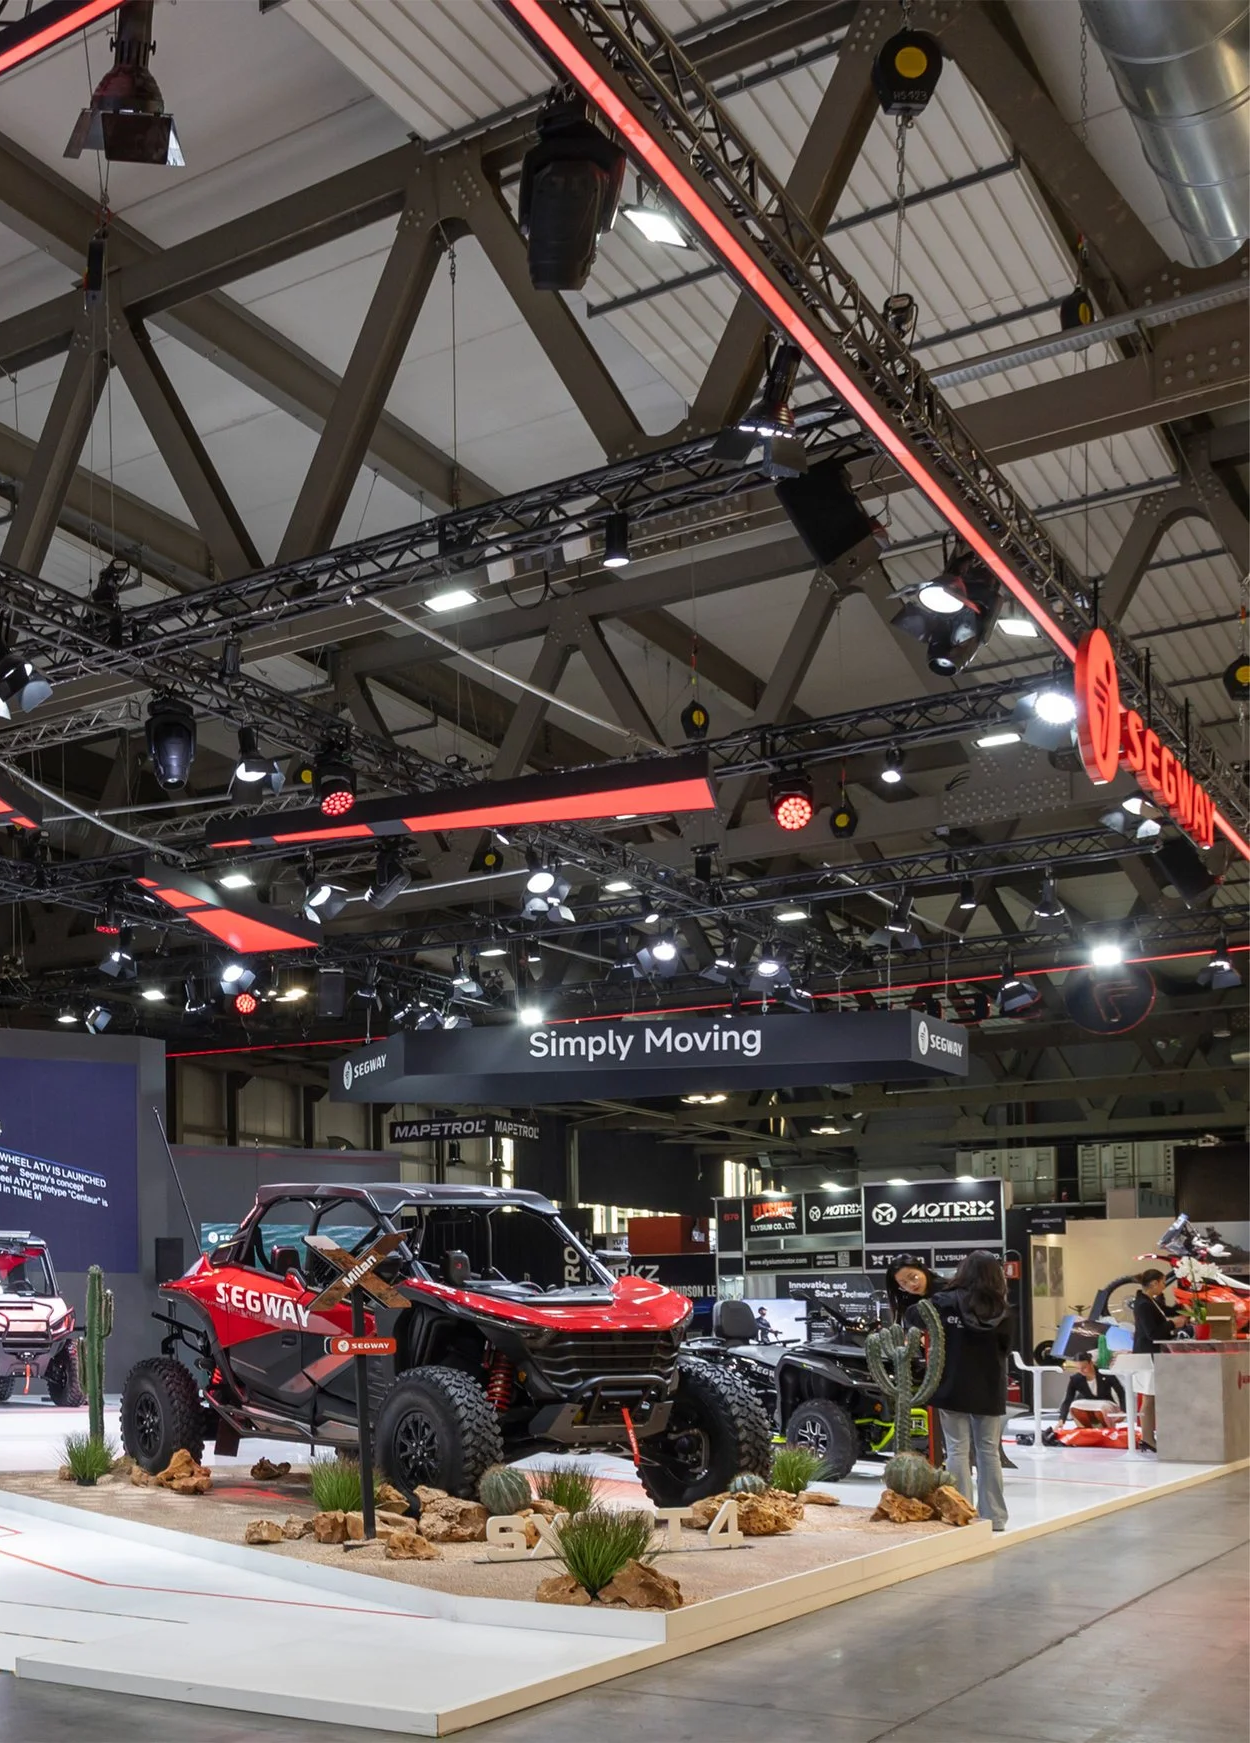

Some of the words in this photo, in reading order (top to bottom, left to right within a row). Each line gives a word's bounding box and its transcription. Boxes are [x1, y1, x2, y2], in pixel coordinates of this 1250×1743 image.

[1124, 709, 1216, 848] SEGWAY
[529, 1029, 634, 1062] Simply
[645, 1023, 762, 1057] Moving
[930, 1033, 963, 1057] SEGWAY
[353, 1053, 387, 1079] SEGWAY
[19, 1168, 56, 1185] Segway's
[56, 1178, 85, 1192] concept
[33, 1161, 52, 1173] ATV
[52, 1166, 61, 1176] IS
[62, 1169, 107, 1188] LAUNCHED
[3, 1185, 11, 1193] in
[12, 1186, 33, 1199] TIME
[13, 1176, 31, 1188] ATV
[32, 1181, 67, 1198] prototype
[102, 1199, 109, 1207] is
[902, 1200, 995, 1218] MOTRIX
[750, 1223, 773, 1232] ELYSIUM
[342, 1254, 377, 1288] Milan
[832, 1282, 848, 1290] and
[215, 1282, 310, 1328] SEGWAY
[351, 1342, 390, 1350] SEGWAY
